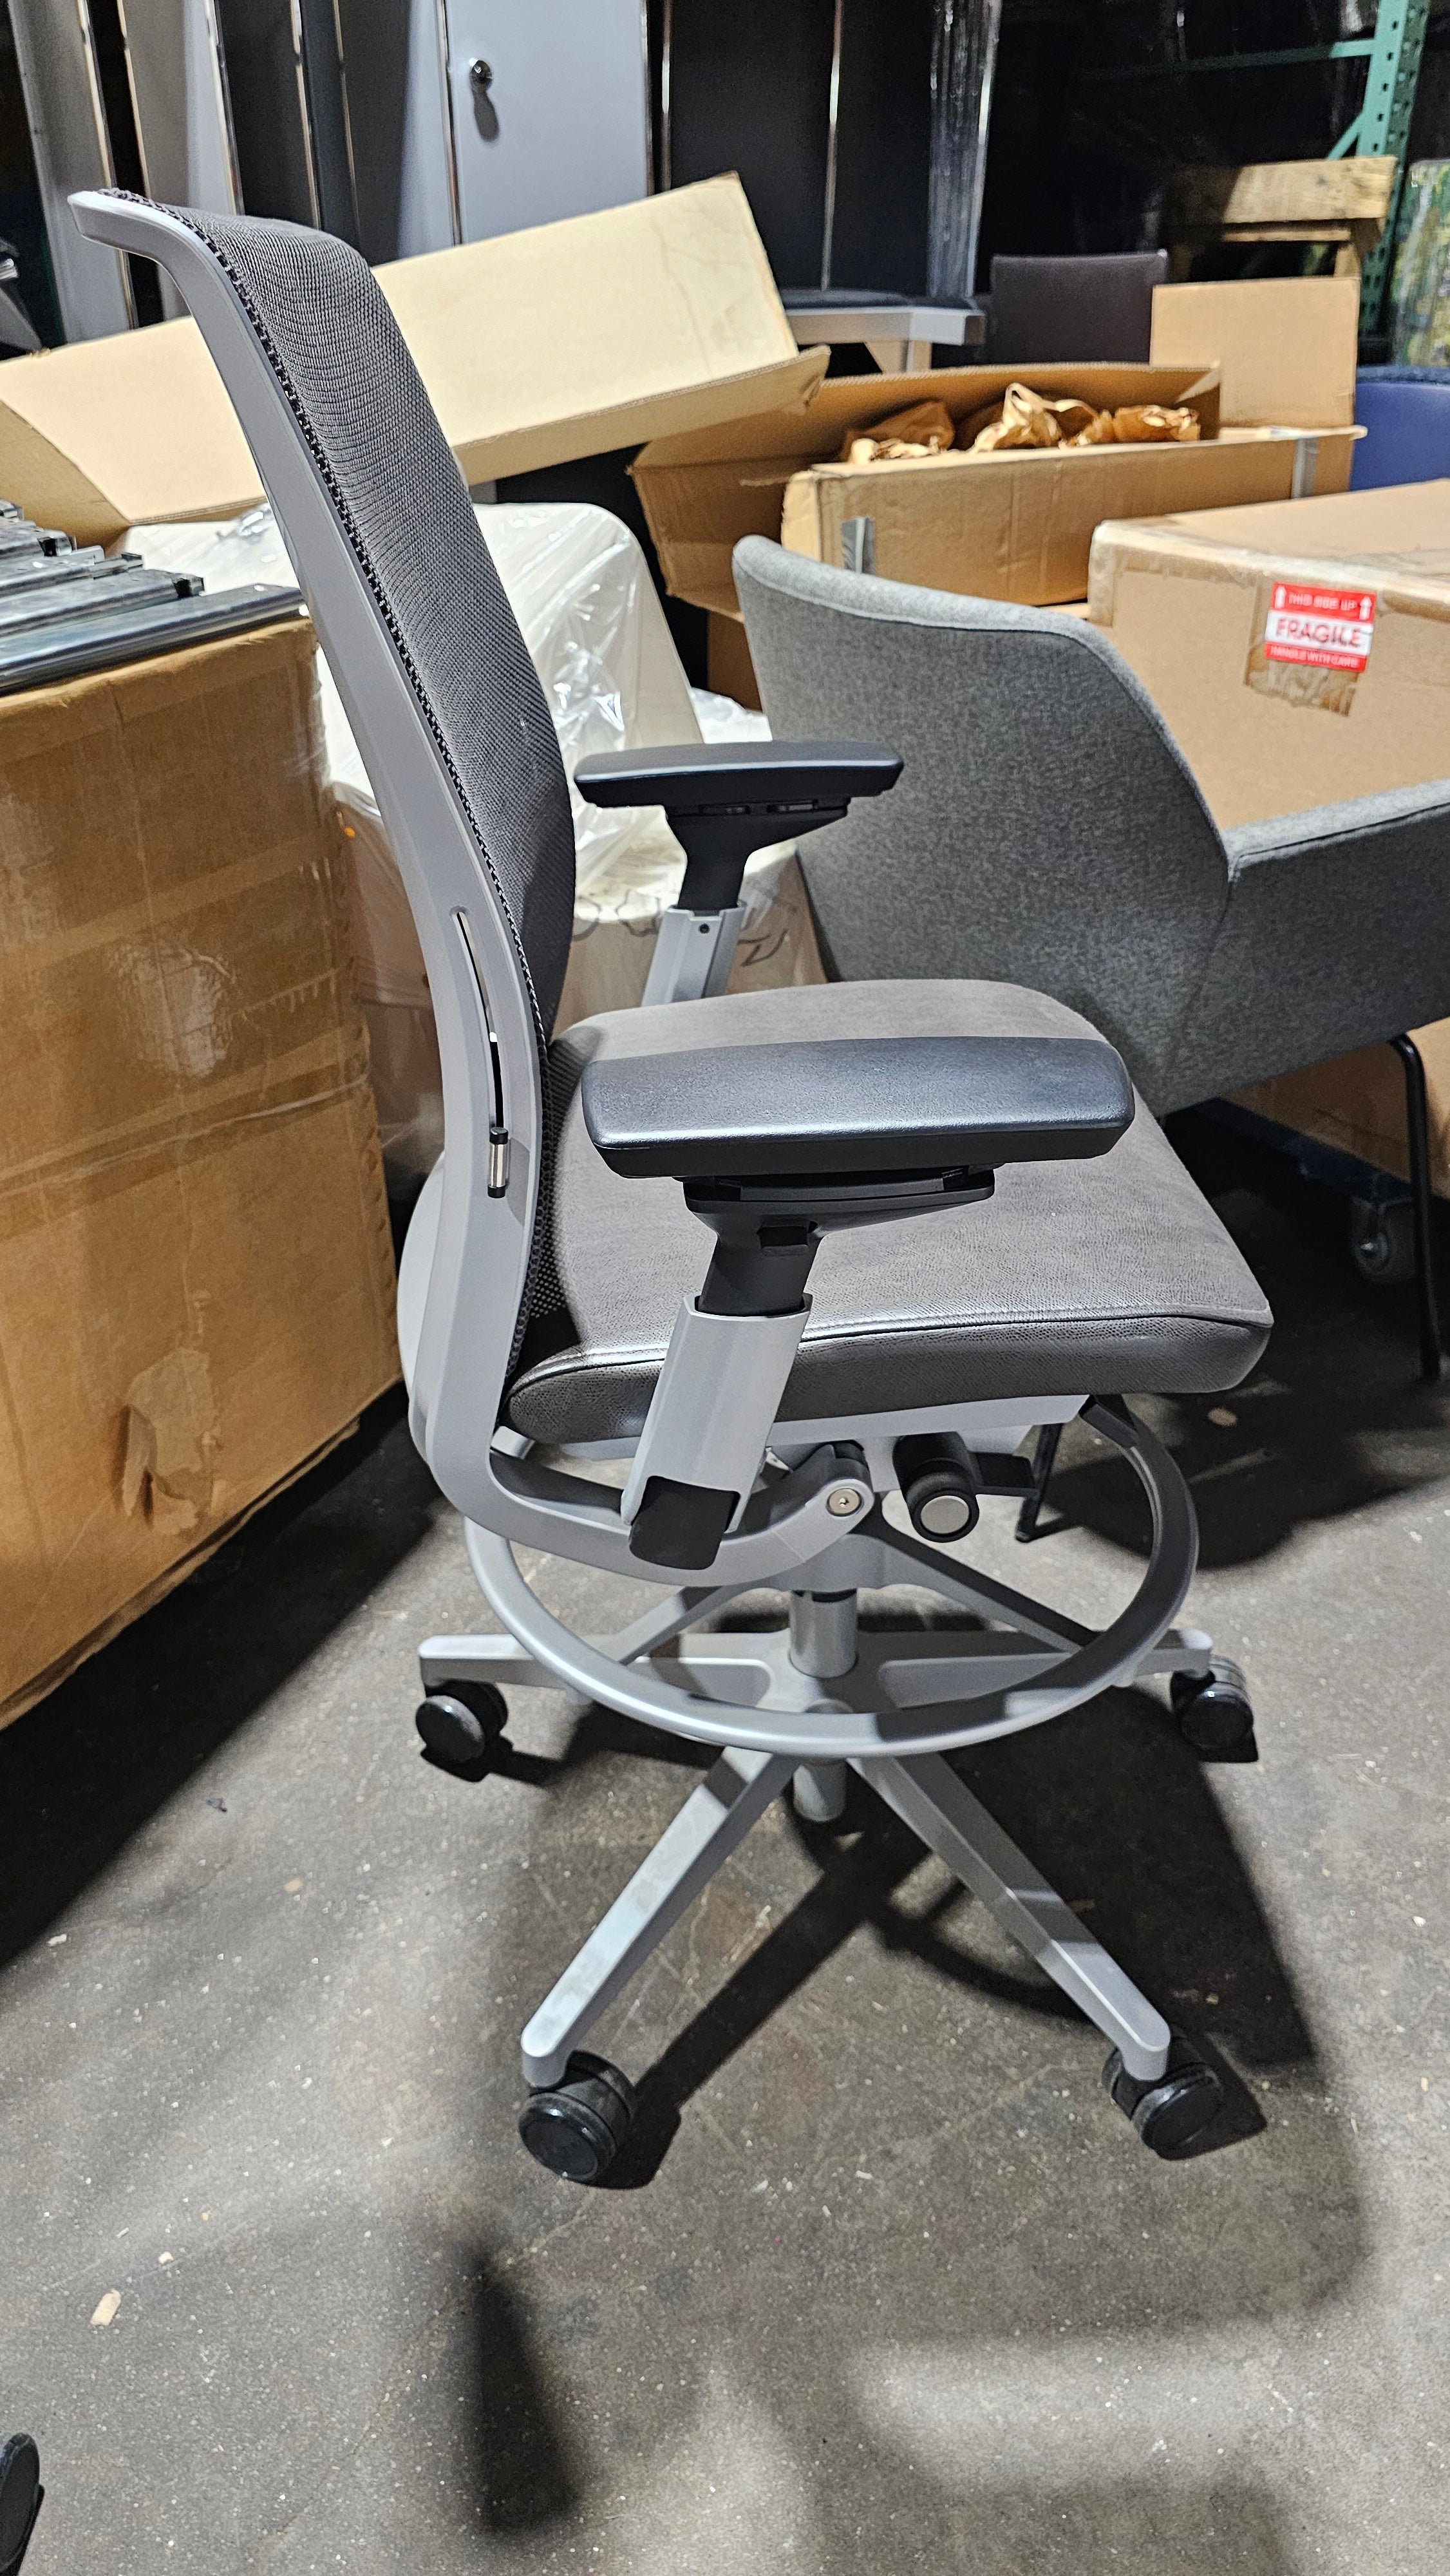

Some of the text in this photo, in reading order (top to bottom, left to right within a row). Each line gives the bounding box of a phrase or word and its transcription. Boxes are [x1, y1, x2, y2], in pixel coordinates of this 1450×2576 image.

[1289, 592, 1357, 611] THIS SIDE UP
[1276, 618, 1361, 647] FRAGILE
[1307, 651, 1330, 663] WITH
[1331, 654, 1359, 668] CARE
